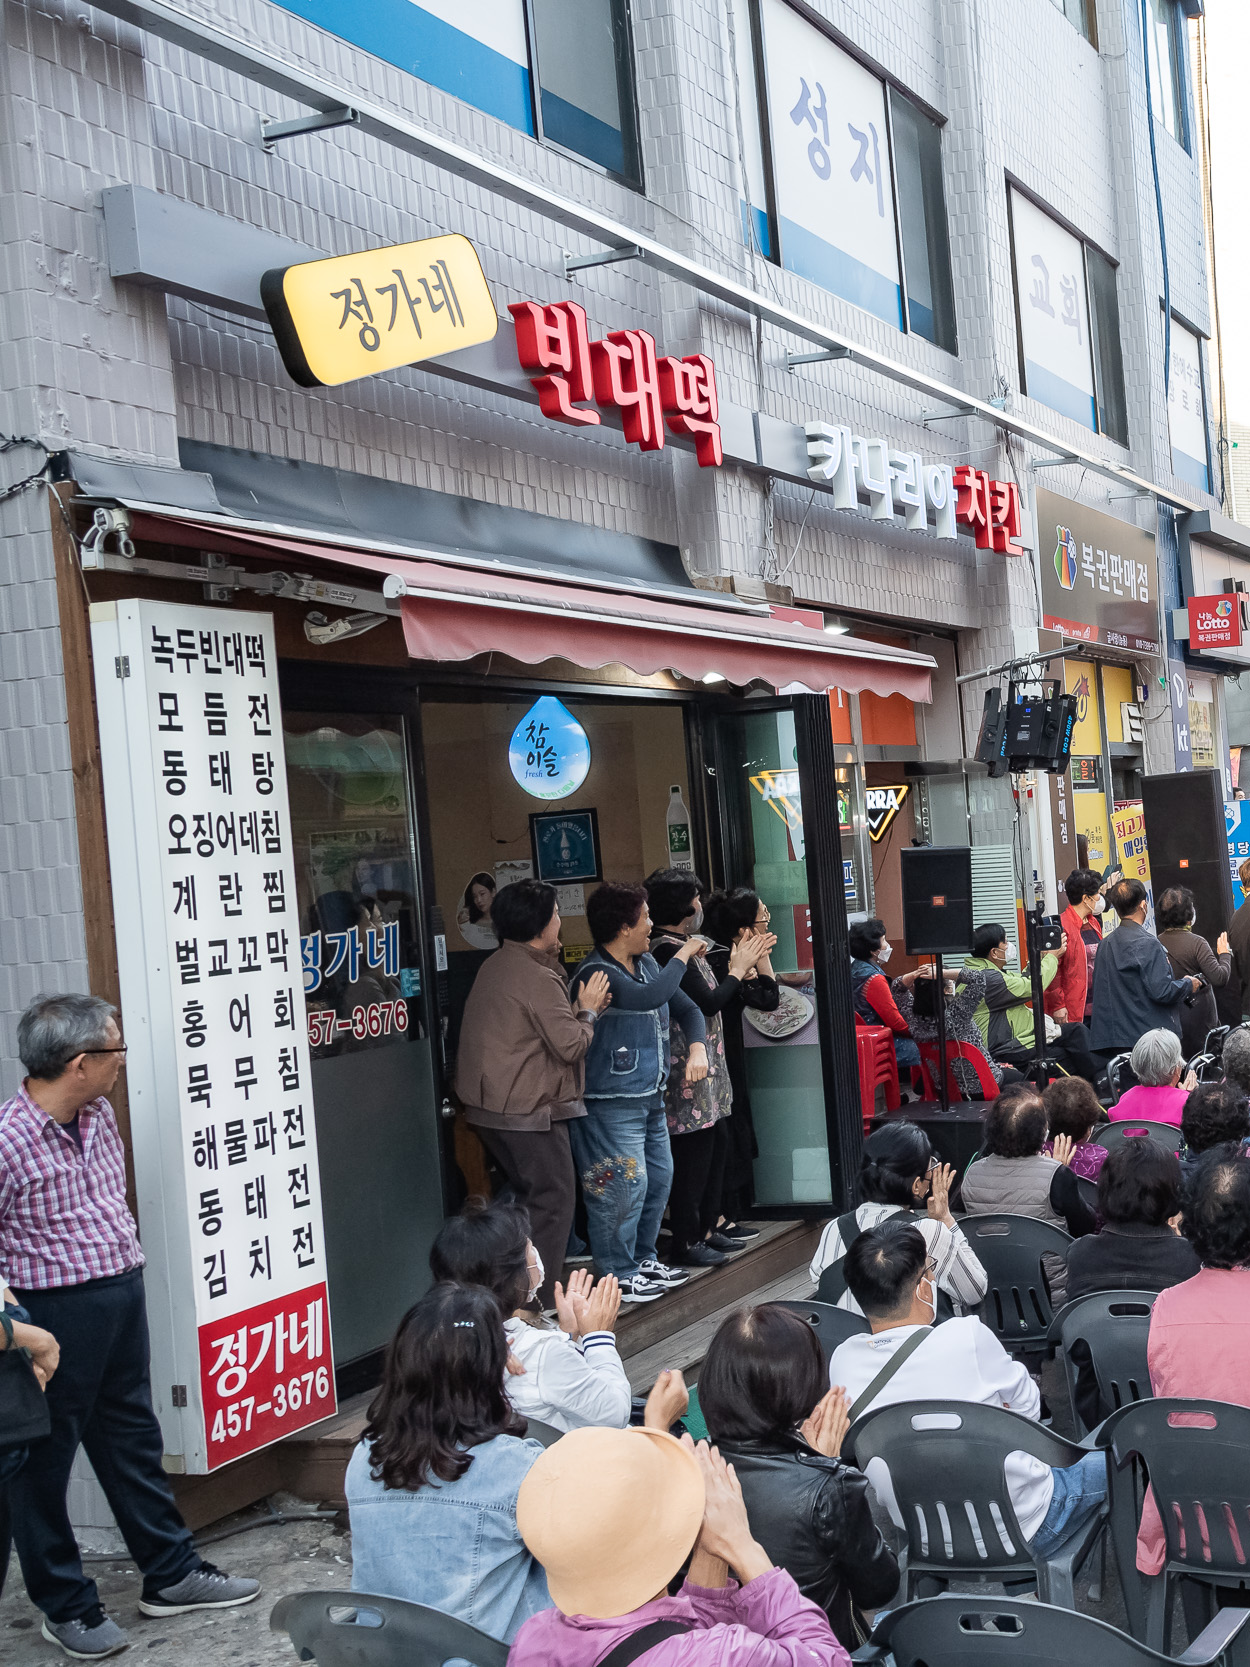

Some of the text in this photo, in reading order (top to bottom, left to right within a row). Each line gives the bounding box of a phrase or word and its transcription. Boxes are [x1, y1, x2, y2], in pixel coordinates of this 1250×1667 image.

[328, 259, 468, 354] 정가네
[507, 300, 724, 468] 빈대떡
[805, 420, 1024, 557] 카나리아 치킨
[1081, 542, 1149, 604] 복권판매점
[151, 625, 267, 678] 녹두빈대떡
[1196, 618, 1230, 631] Lotto
[1176, 723, 1189, 752] kt
[524, 769, 543, 779] fresh
[167, 810, 282, 858] 오징어데침
[300, 919, 400, 994] 정가네
[192, 1103, 306, 1171] 해물파전
[207, 1297, 324, 1398] 정가네
[210, 1365, 330, 1444] 457-3676
